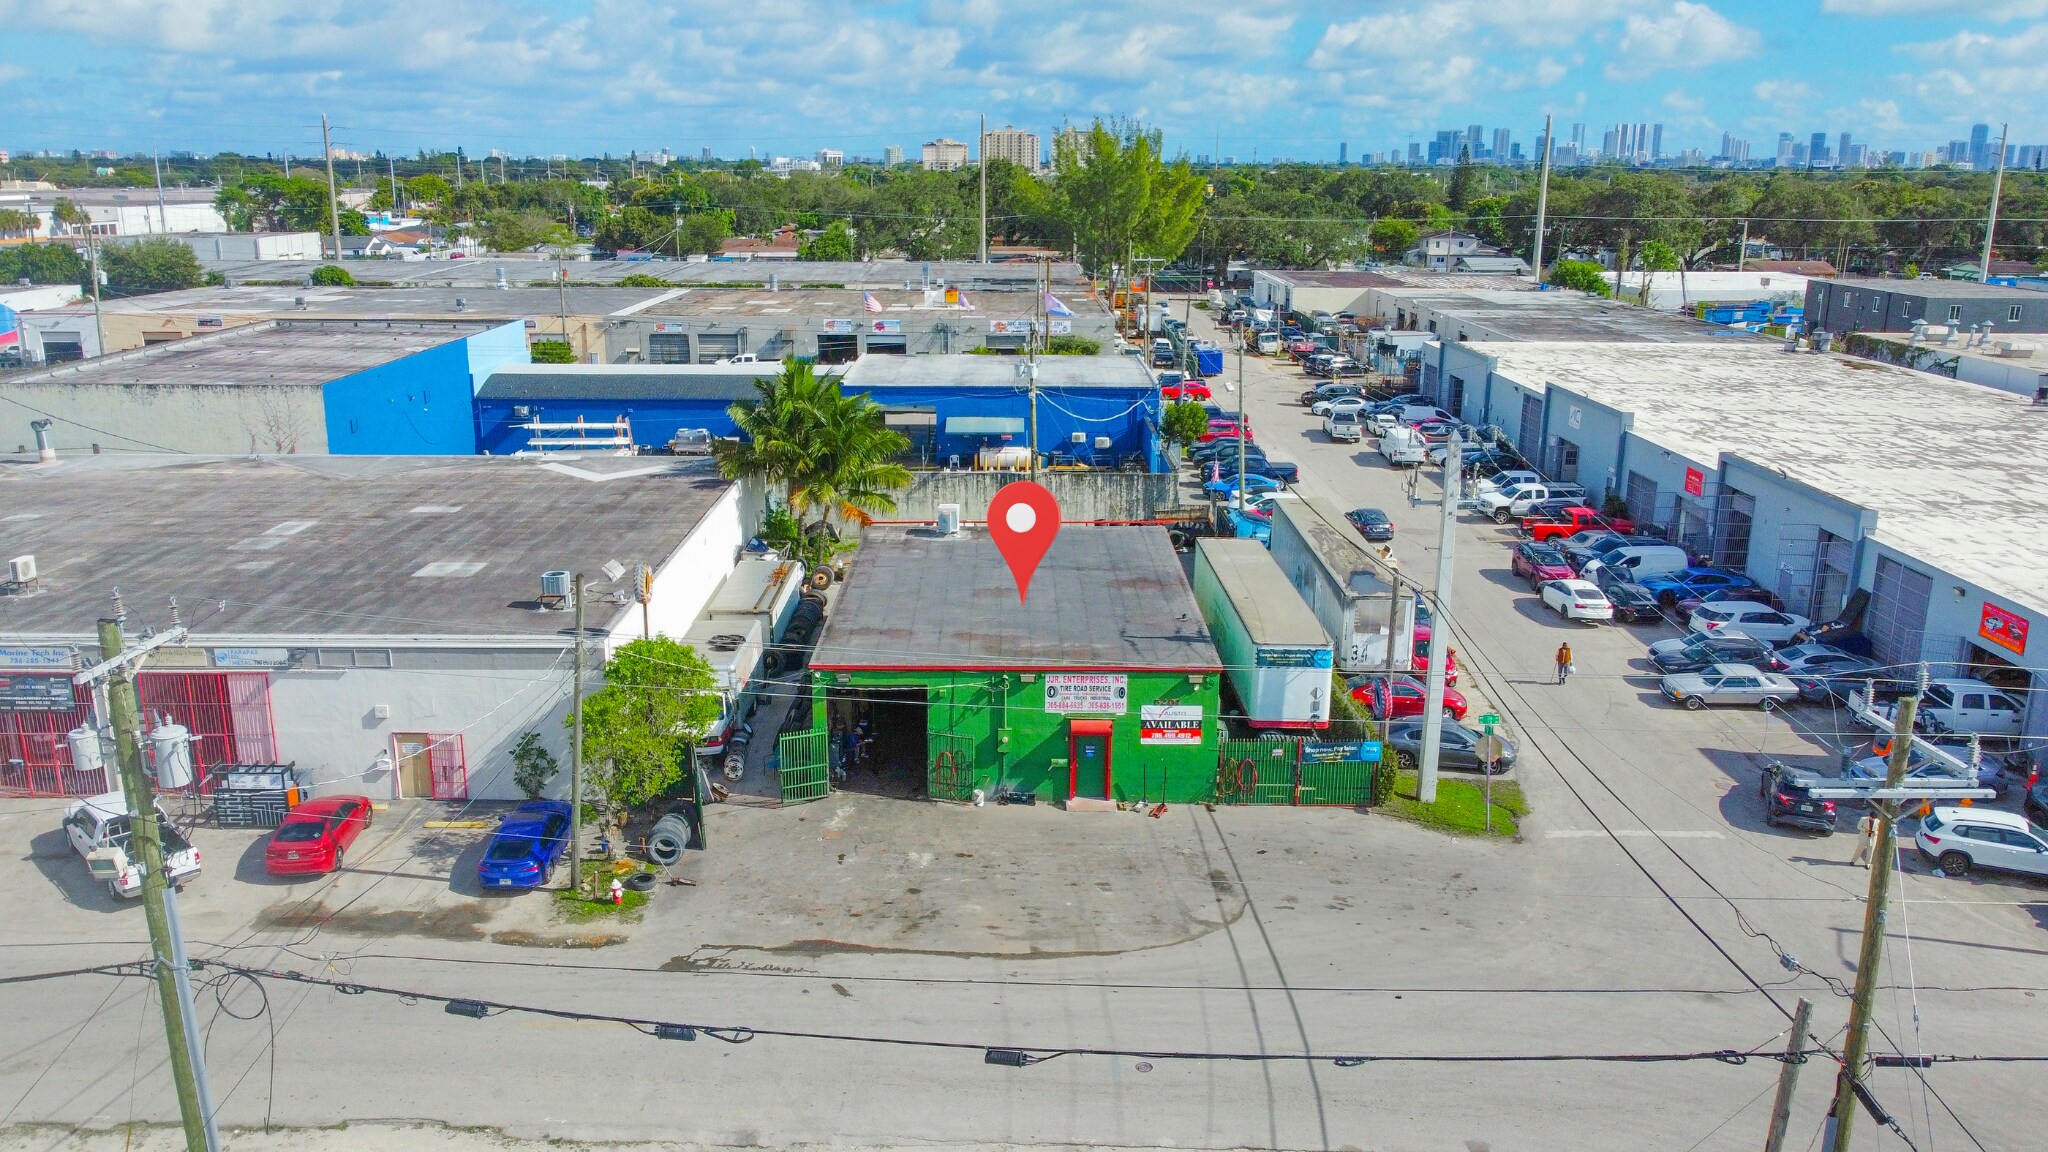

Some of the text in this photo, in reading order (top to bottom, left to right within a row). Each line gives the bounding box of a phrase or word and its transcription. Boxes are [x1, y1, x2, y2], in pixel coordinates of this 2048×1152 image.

[1112, 675, 1126, 684] INC.
[1144, 721, 1199, 729] AVAILABLE
[1304, 746, 1319, 754] Shop
